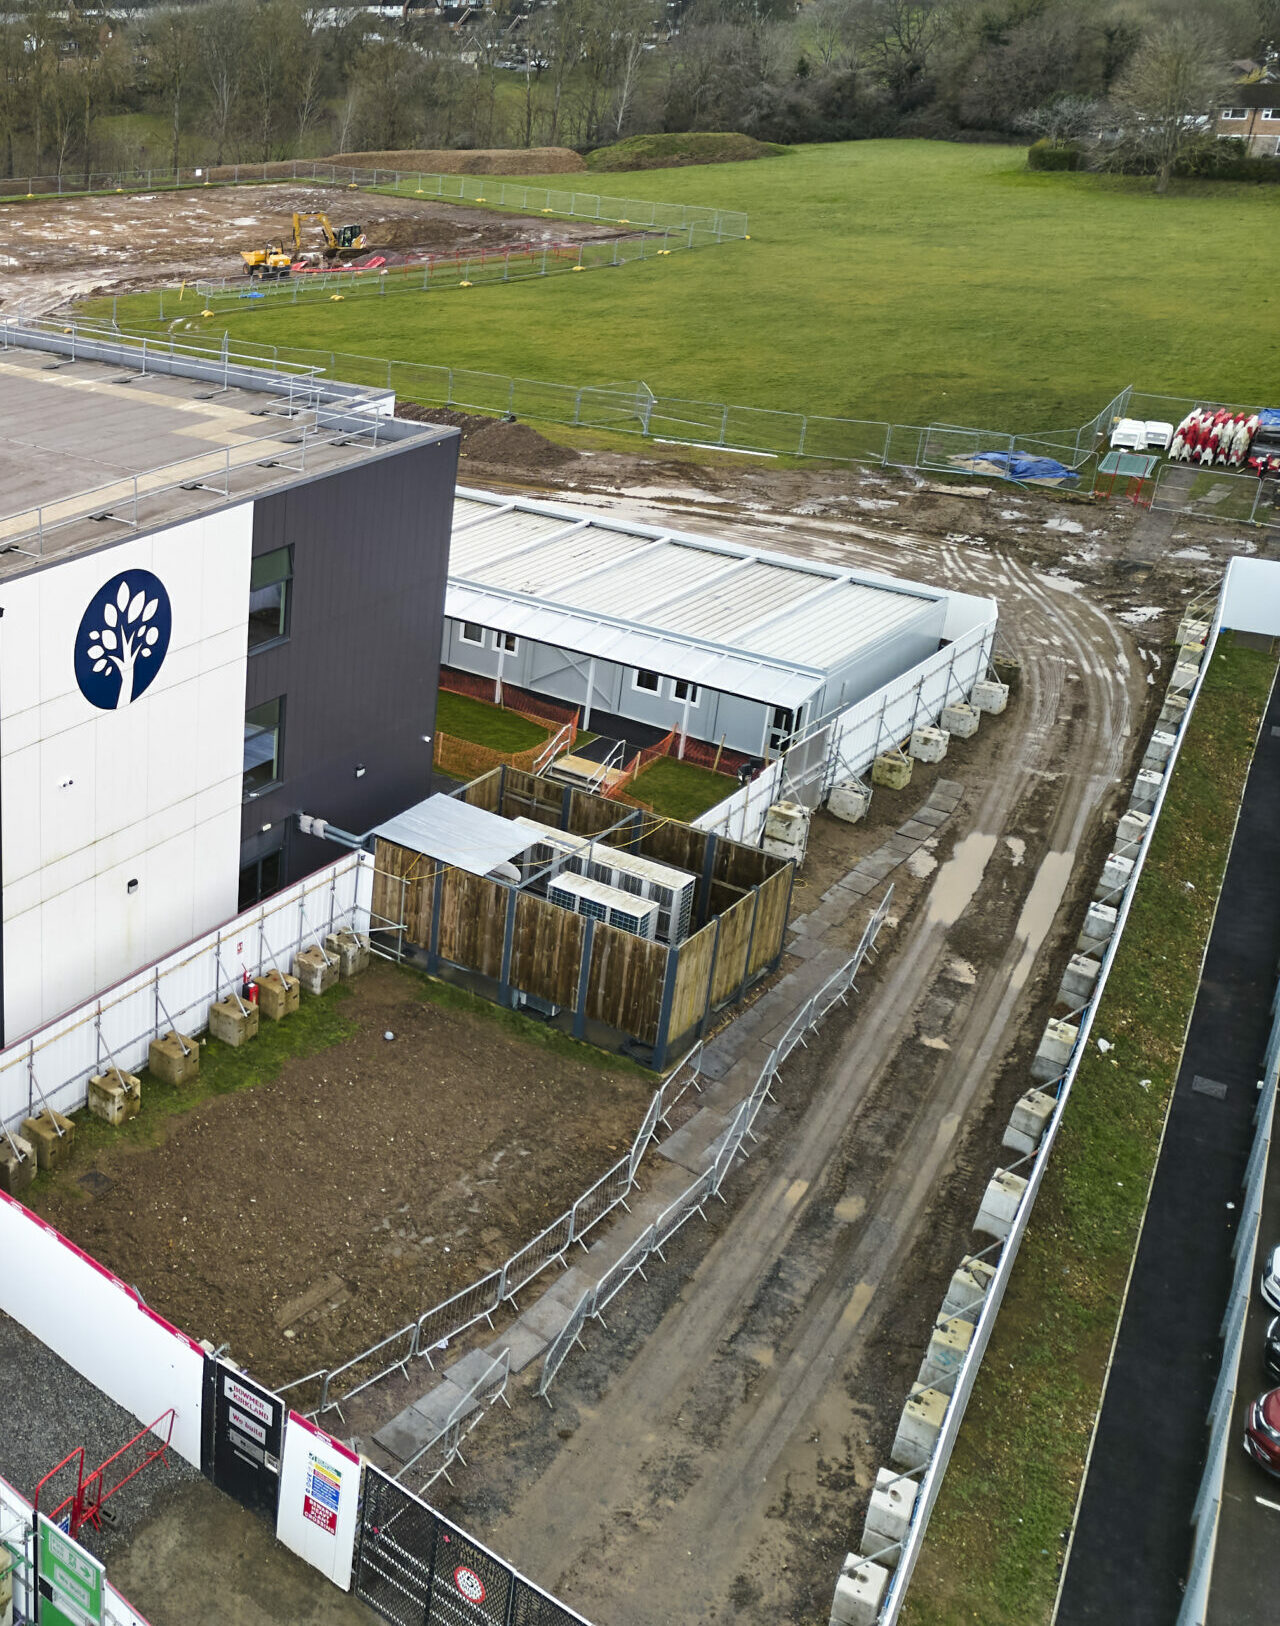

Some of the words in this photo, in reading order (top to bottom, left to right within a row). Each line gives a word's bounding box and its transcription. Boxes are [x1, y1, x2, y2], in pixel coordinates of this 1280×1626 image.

[233, 1412, 244, 1425] We
[244, 1421, 263, 1438] build
[309, 1498, 333, 1518] BEWARE
[311, 1505, 330, 1521] HEAVY
[311, 1510, 330, 1526] PLANT
[304, 1511, 335, 1534] CROSSING
